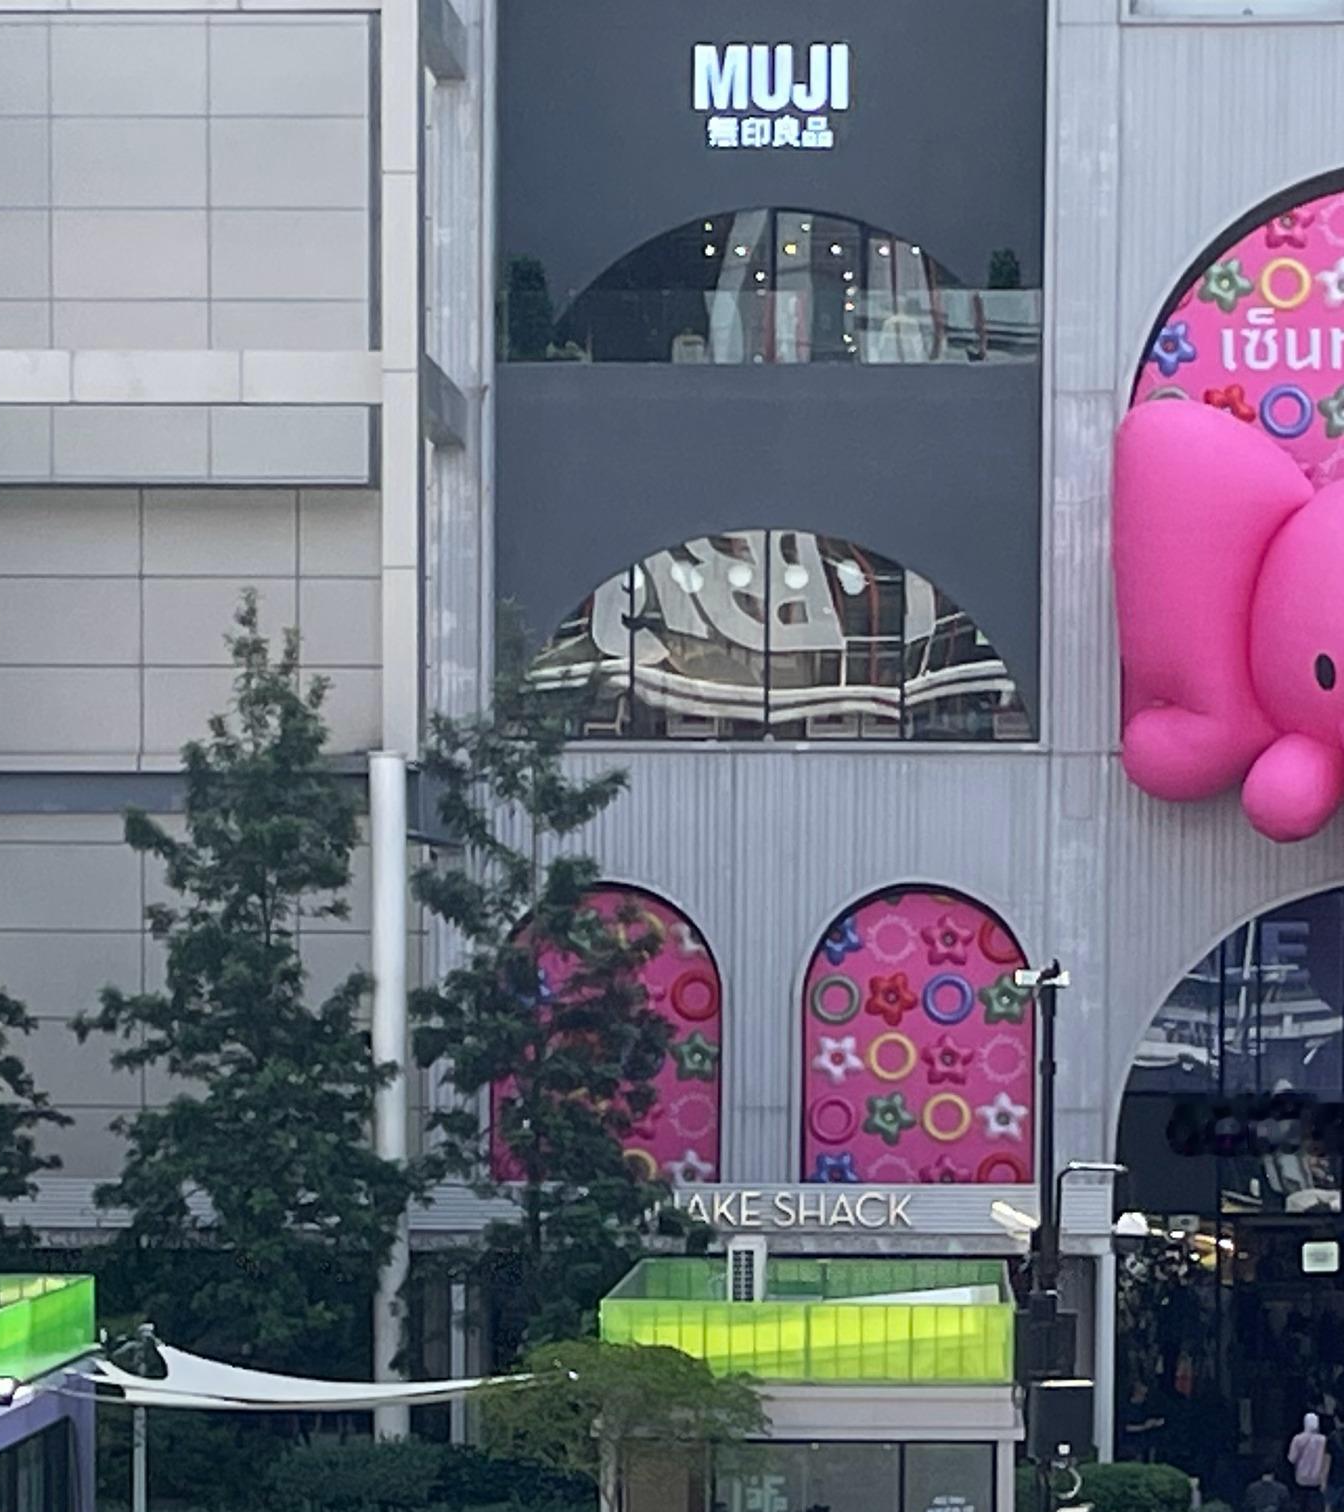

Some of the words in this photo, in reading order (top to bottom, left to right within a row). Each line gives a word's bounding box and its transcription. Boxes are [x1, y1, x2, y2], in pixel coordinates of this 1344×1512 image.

[694, 43, 849, 111] MUJI
[708, 114, 834, 148] 無印良品
[773, 1189, 912, 1228] SHACK
